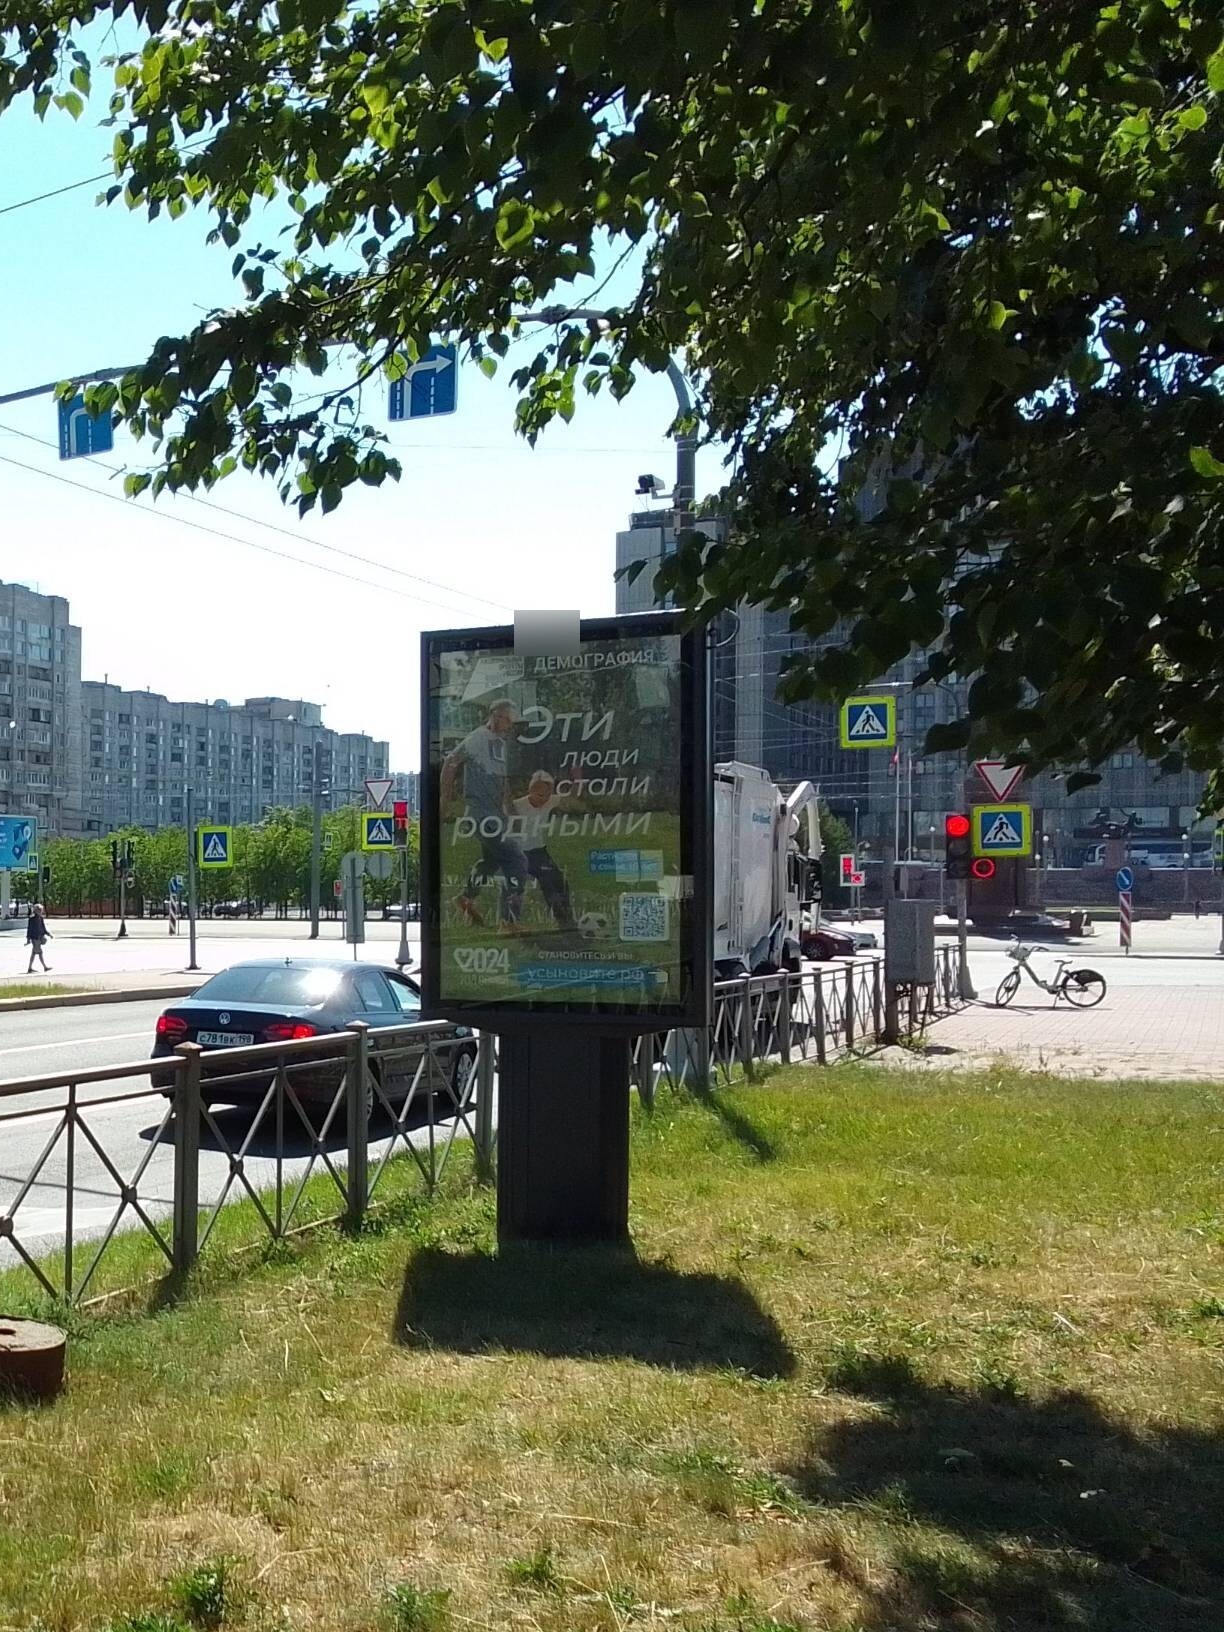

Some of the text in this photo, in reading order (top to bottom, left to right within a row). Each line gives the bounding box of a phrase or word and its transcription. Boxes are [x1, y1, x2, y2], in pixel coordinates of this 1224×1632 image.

[533, 649, 655, 673] ДЕМОГРАФИЯ
[517, 706, 615, 744] Эти
[560, 748, 639, 769] люди
[556, 776, 651, 797] стали
[451, 812, 653, 846] родными
[454, 948, 511, 973] 2024
